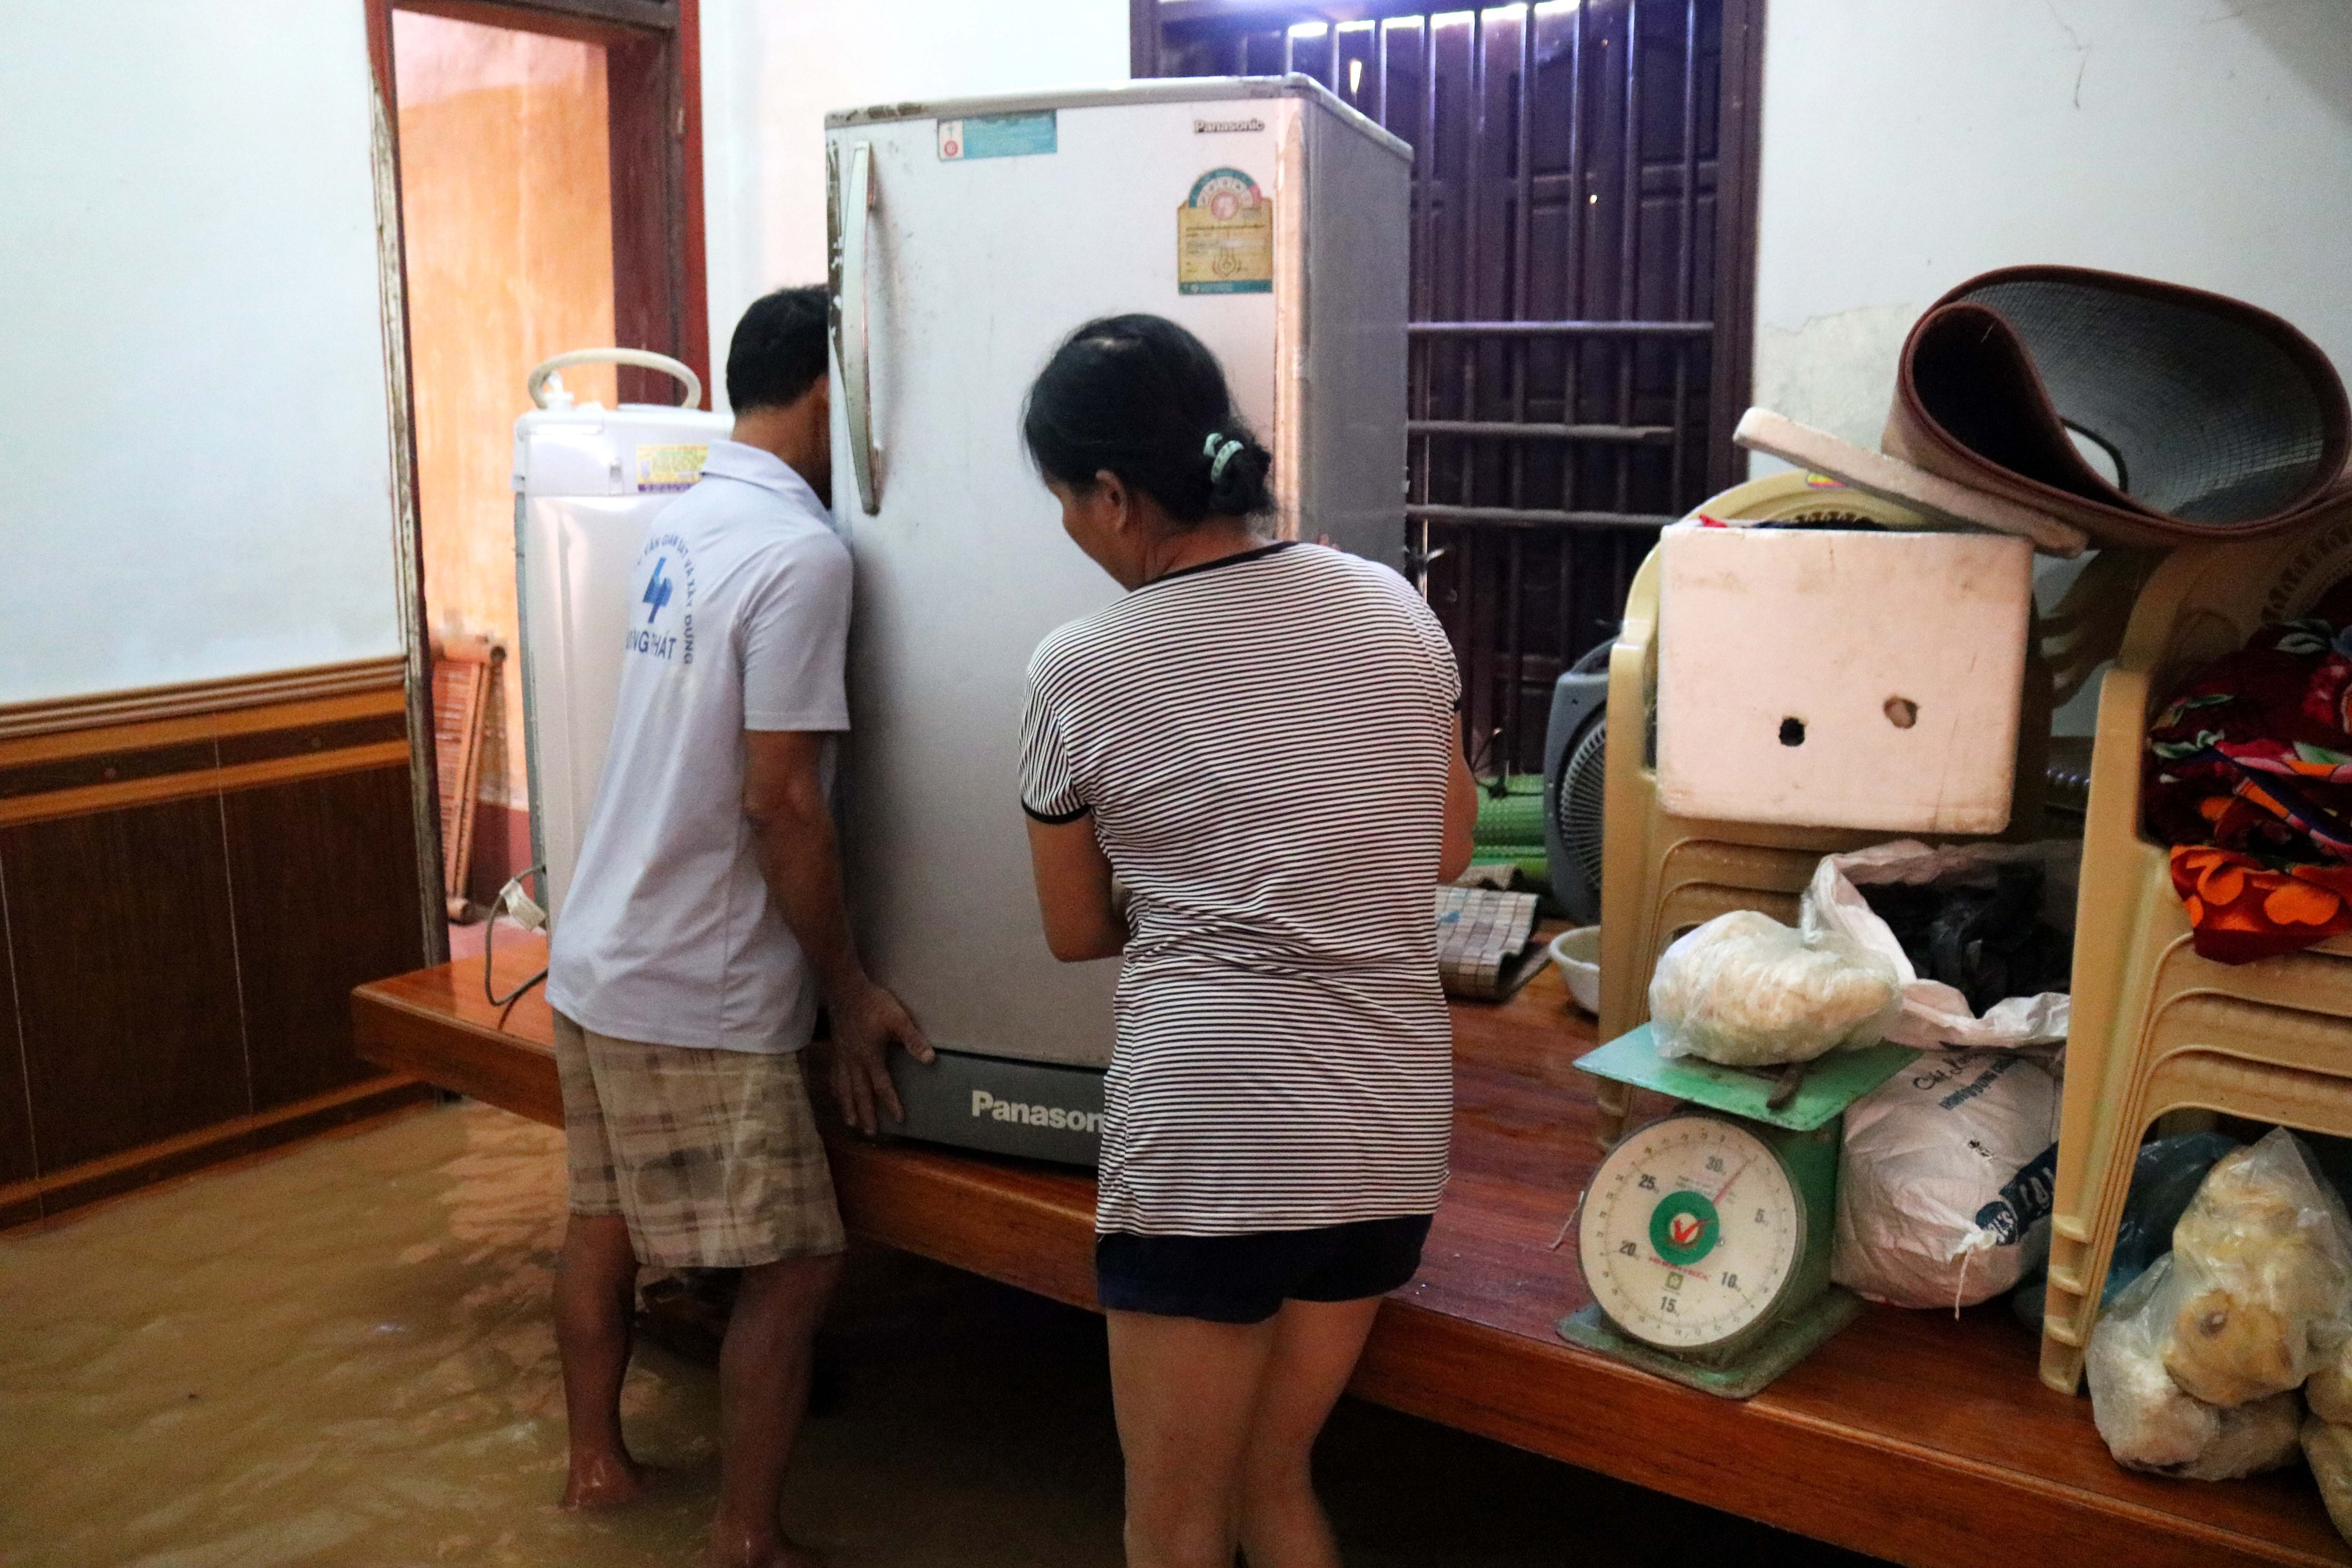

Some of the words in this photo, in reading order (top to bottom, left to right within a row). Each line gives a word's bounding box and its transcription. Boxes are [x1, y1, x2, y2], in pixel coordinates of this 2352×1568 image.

[1194, 118, 1265, 133] Panasonic
[1639, 1174, 1656, 1190] 25
[1755, 1208, 1765, 1223] 5
[1619, 1240, 1637, 1256] 20
[1721, 1272, 1737, 1288] 10
[1660, 1296, 1677, 1312] 15
